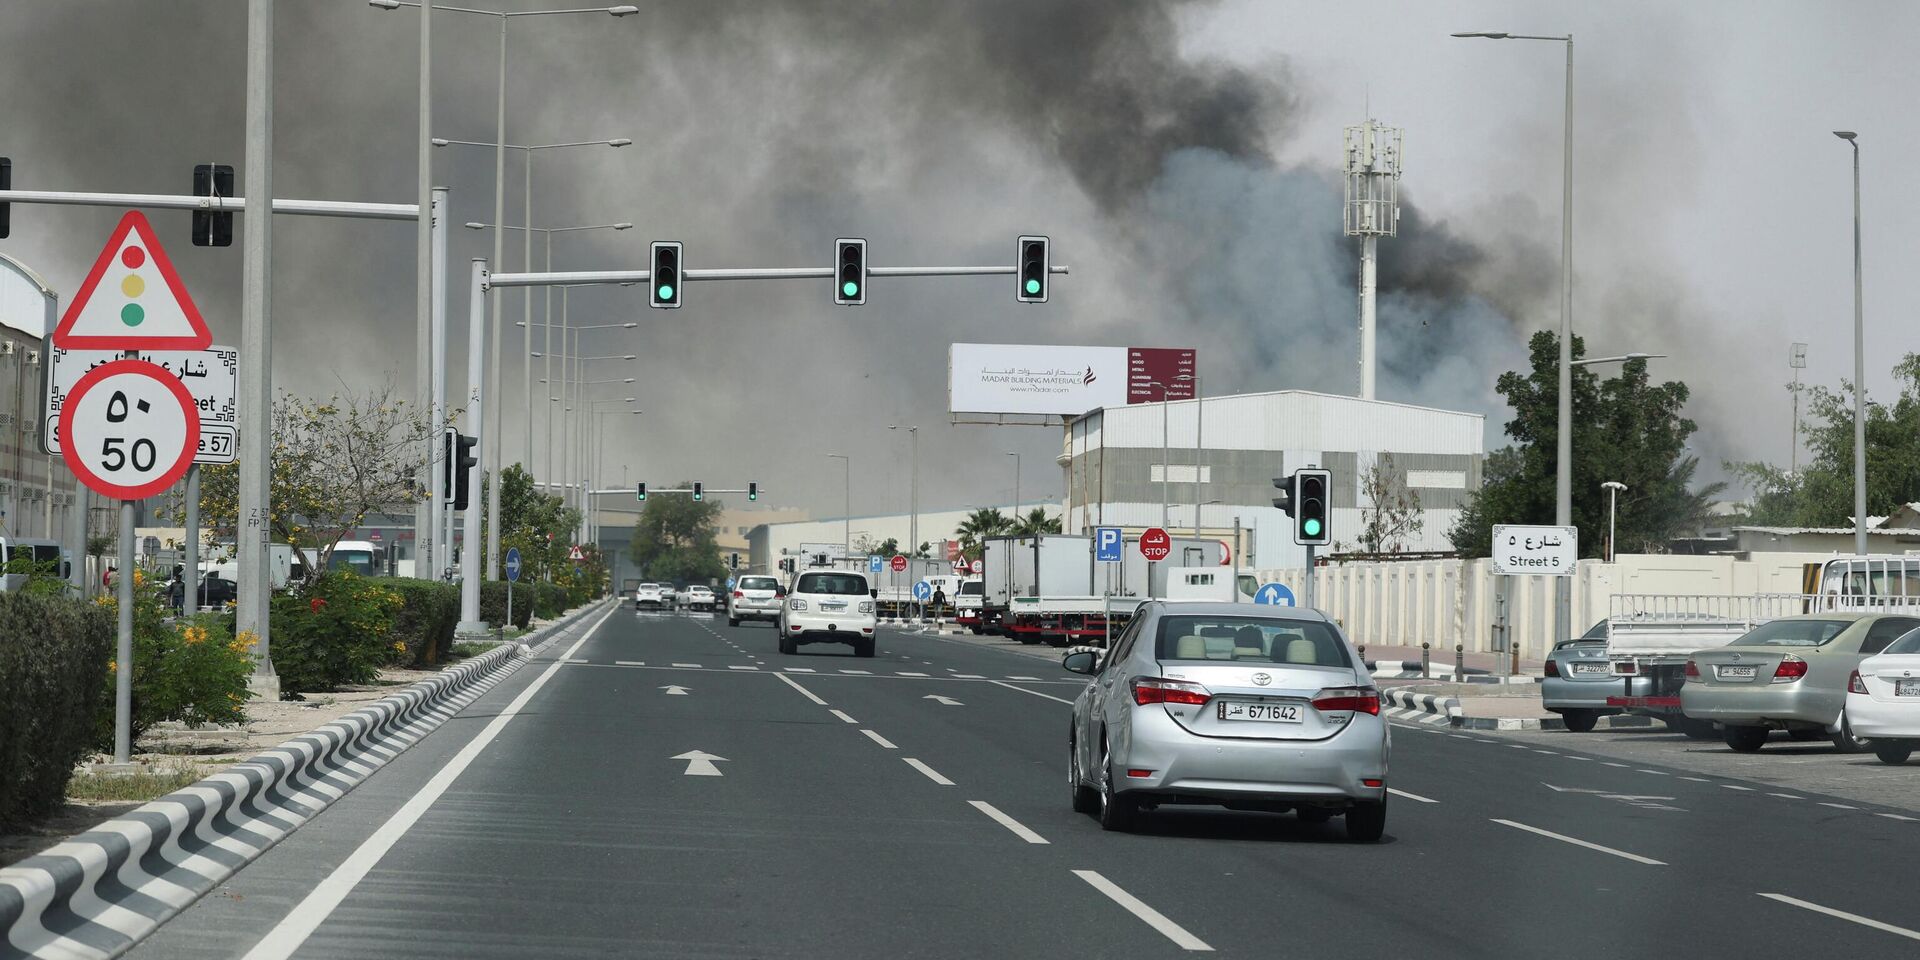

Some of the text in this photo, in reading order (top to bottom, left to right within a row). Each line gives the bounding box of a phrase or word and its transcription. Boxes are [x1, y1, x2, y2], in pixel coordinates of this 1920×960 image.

[981, 375, 1082, 385] MADAR BUILDING MATERIALS
[106, 390, 151, 423] ٥٠
[210, 436, 230, 453] 57
[101, 437, 157, 473] 50
[251, 508, 258, 518] Z
[248, 518, 260, 528] FP
[1101, 530, 1117, 551] P
[1146, 533, 1164, 544] قف
[1508, 535, 1562, 551] شارع ٥
[1144, 547, 1168, 557] STOP
[872, 556, 881, 567] P
[1509, 555, 1560, 567] Street 5
[1227, 705, 1243, 717] قطر
[1249, 705, 1297, 720] 671642
